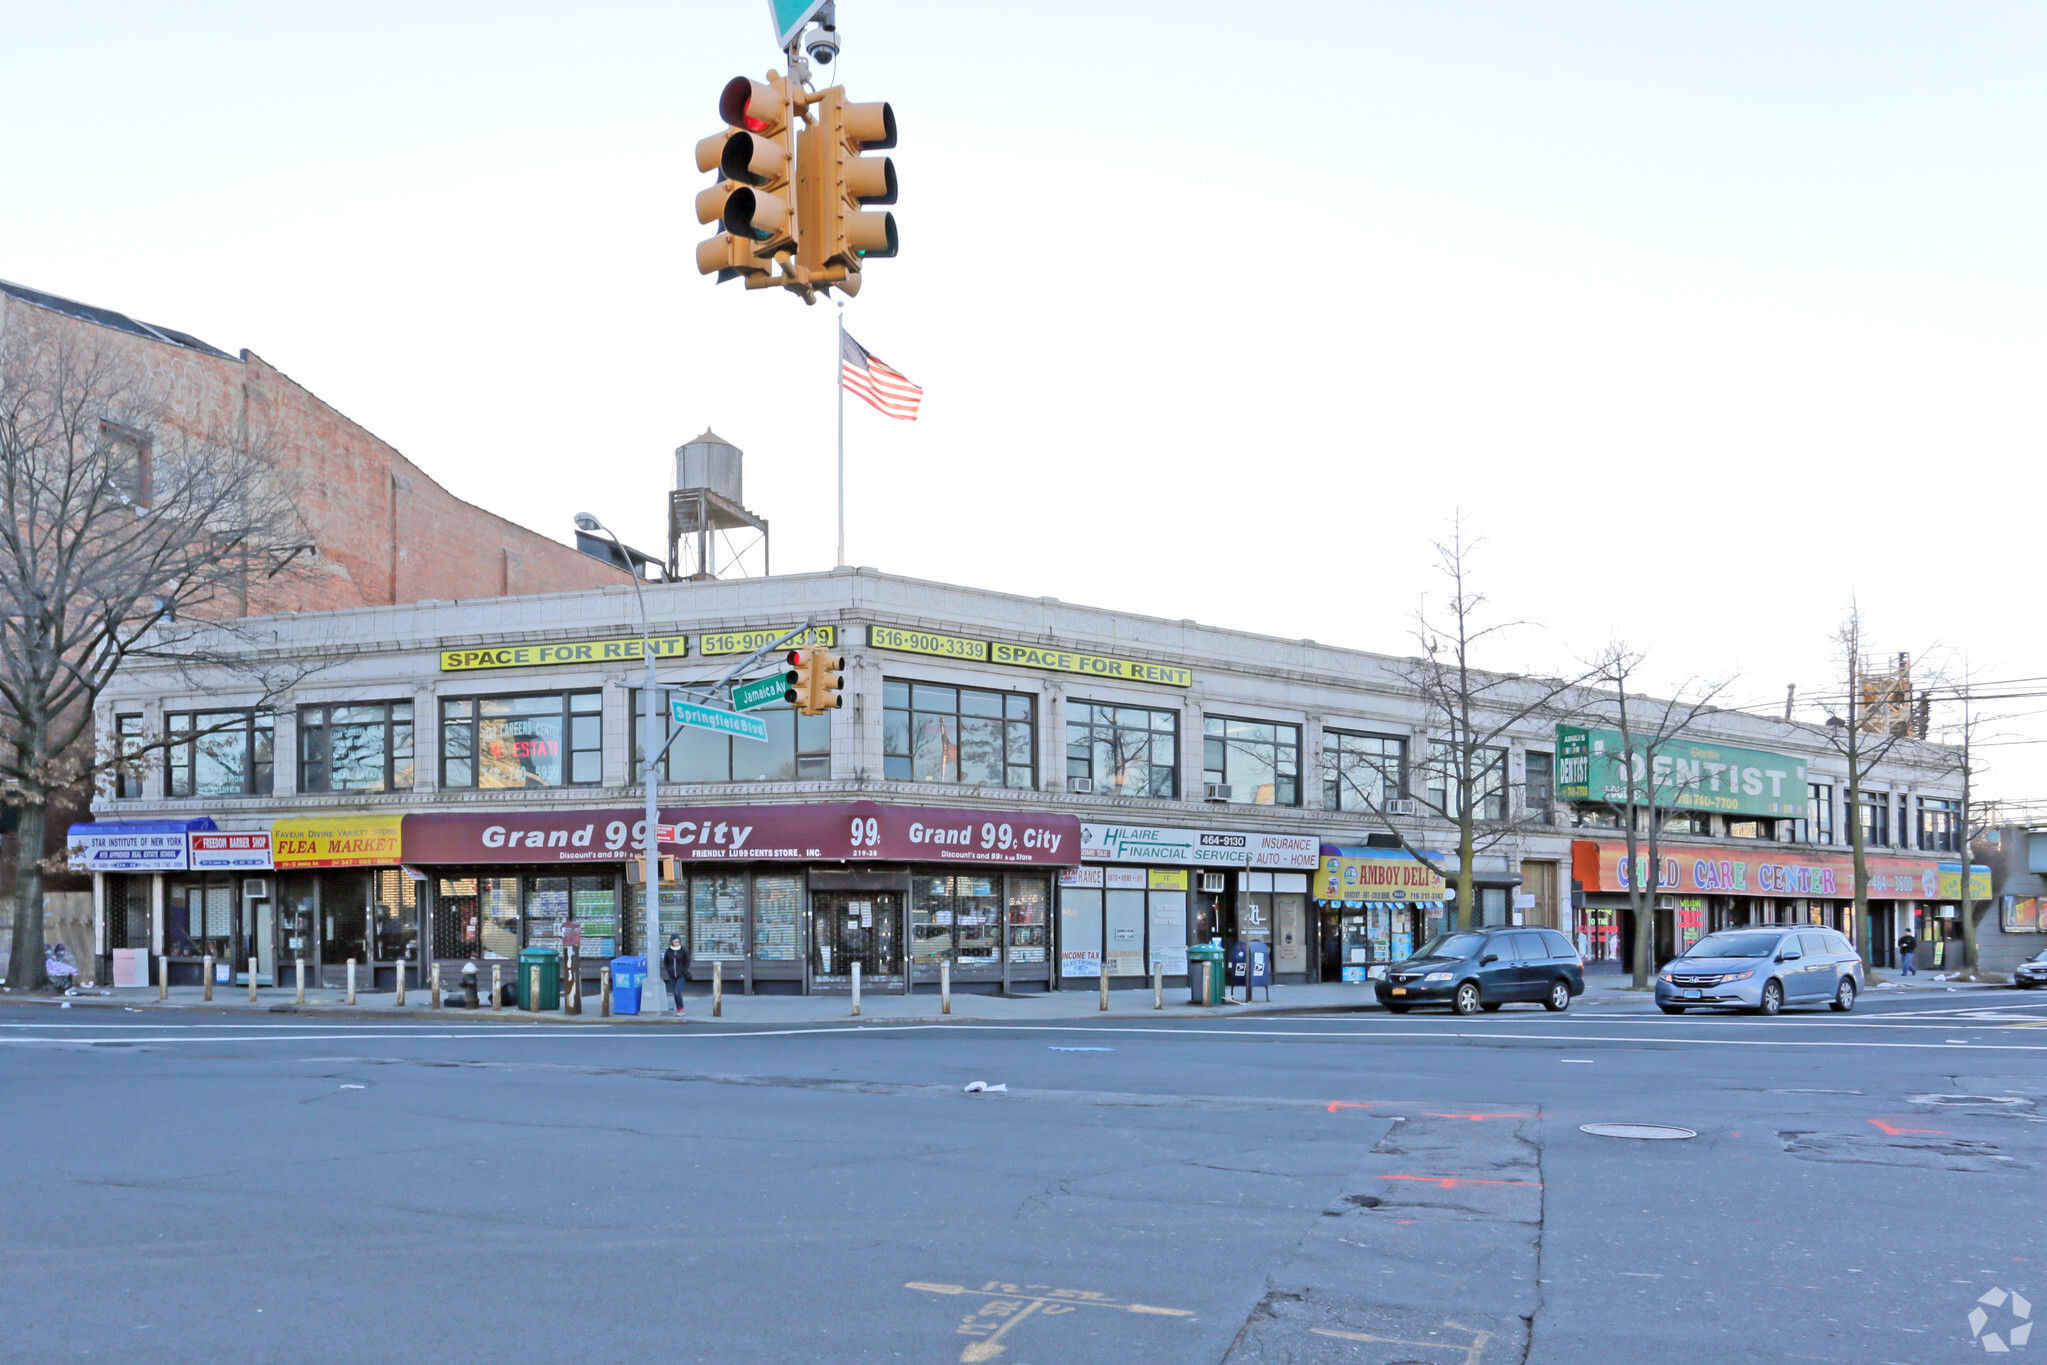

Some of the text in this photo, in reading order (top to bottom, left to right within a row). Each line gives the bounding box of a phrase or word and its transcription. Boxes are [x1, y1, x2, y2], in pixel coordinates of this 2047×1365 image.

[447, 638, 680, 668] SPACE FOR RENT
[997, 646, 1187, 684] SPACE FOR RENT
[743, 680, 786, 704] Jamaica Av
[676, 706, 764, 736] Springfield Blvd
[500, 720, 532, 738] CAREERS
[1690, 746, 1720, 760] Gentle
[1560, 756, 1588, 784] DENTIST
[1619, 751, 1787, 798] DENTIST
[308, 830, 334, 838] DIVINE
[372, 828, 397, 836] STORE
[482, 824, 594, 848] Grand
[675, 821, 754, 850] City
[909, 822, 972, 845] Grand
[1023, 828, 1062, 854] City
[1104, 828, 1160, 846] HILAIRE
[92, 837, 182, 848] STAR INSTITUTE OF NEW YORK
[202, 836, 266, 848] FREEDOM BARBER SHOP
[278, 838, 398, 854] FLEA MARKET
[1202, 835, 1244, 846] 464-9130
[1262, 838, 1312, 850] INSURANCE
[560, 851, 597, 859] Discount's
[692, 850, 726, 858] FRIENDLY
[728, 850, 748, 858] LU99
[750, 849, 773, 857] CENTS
[806, 849, 822, 857] INC.
[941, 850, 976, 859] Discount's
[976, 852, 990, 860] and
[1118, 841, 1253, 862] FINANCIAL SERVICES
[1256, 852, 1316, 866] AUTO HOME
[1062, 868, 1078, 878] ATM
[1078, 870, 1101, 884] RANCE
[1134, 874, 1143, 882] LIFE
[1360, 865, 1430, 886] AMBOY DELI
[1693, 858, 1747, 891] CARE
[1758, 862, 1837, 894] CENTER
[1968, 878, 1987, 893] RVICE
[1062, 951, 1100, 960] INCOME TAX
[1063, 960, 1100, 968] ELECTRONIC
